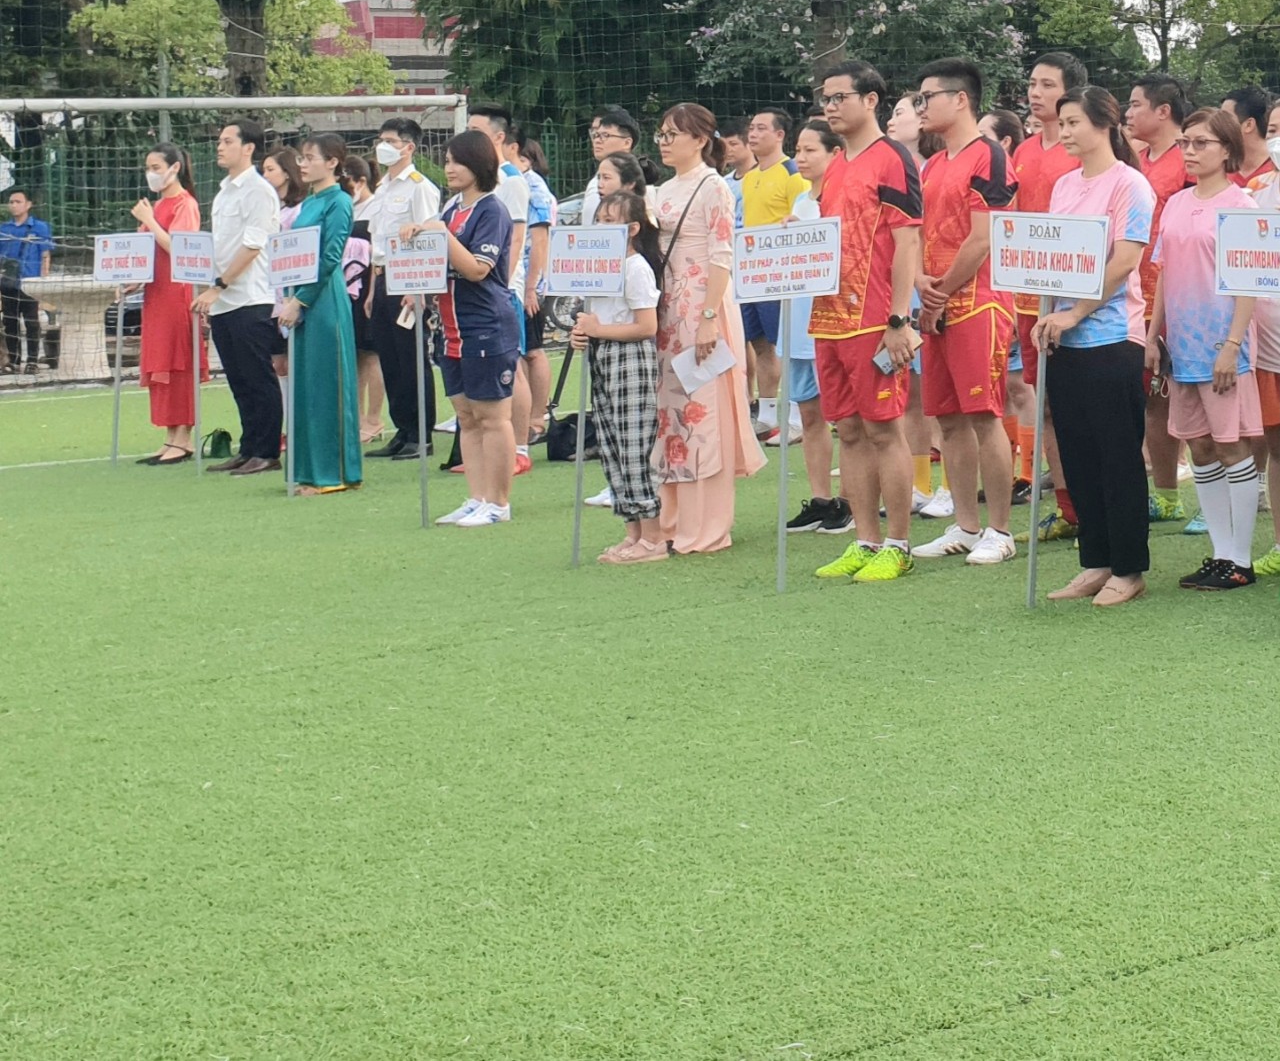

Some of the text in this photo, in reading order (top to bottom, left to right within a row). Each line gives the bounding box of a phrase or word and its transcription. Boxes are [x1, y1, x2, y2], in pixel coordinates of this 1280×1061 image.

[758, 228, 826, 249] LQ CHI ĐOÀN
[1029, 222, 1061, 238] ĐOÀN
[1000, 244, 1019, 272] BỆNH
[1021, 246, 1035, 273] VIỆN
[1050, 252, 1073, 273] KHOA
[1076, 246, 1096, 274] TỈNH
